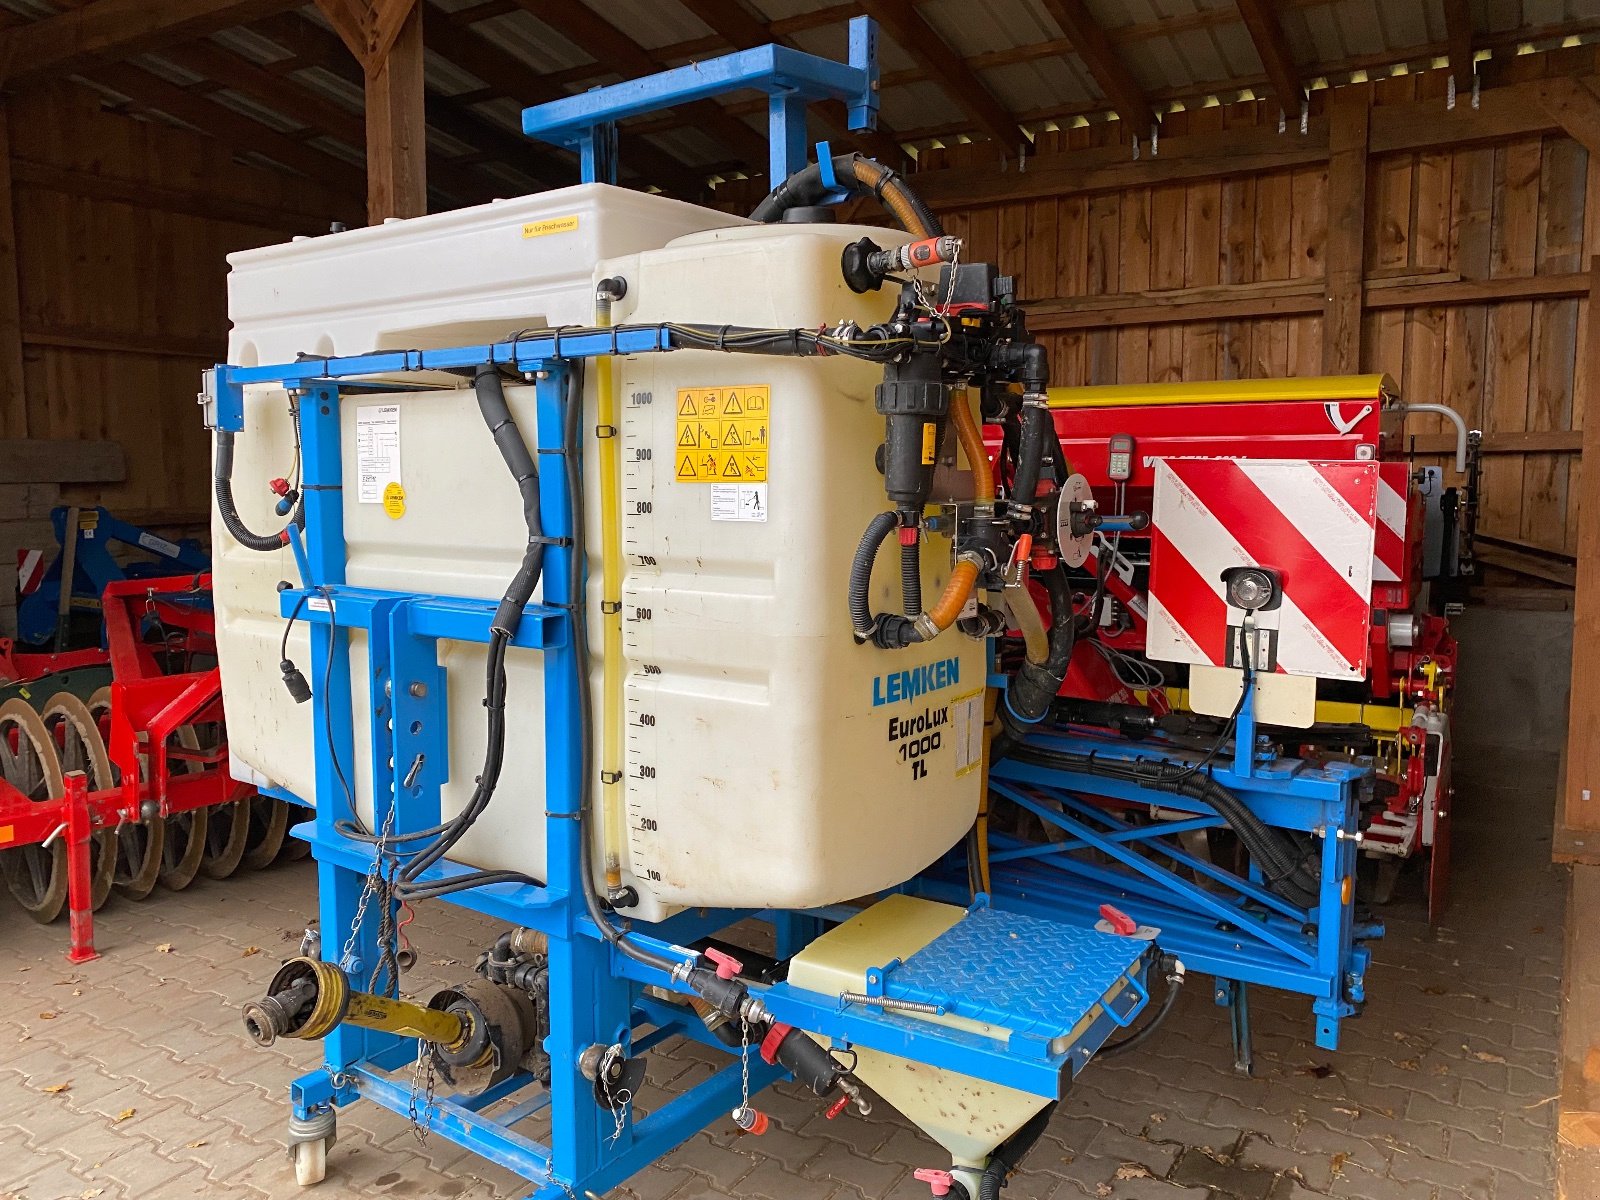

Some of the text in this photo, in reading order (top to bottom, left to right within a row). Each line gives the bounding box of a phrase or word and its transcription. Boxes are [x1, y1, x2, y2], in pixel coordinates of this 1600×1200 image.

[631, 392, 652, 405] 1000
[636, 449, 652, 460] 900
[636, 502, 652, 513] 800
[638, 556, 656, 565] 700
[636, 608, 652, 620] 600
[643, 664, 661, 675] 500
[873, 656, 959, 706] LEMKEN
[639, 713, 656, 727] 400
[888, 706, 948, 741] EuroLux
[899, 732, 941, 762] 1000
[639, 765, 656, 779] 300
[912, 759, 928, 781] TL
[641, 818, 658, 832] 200
[646, 869, 661, 882] 100
